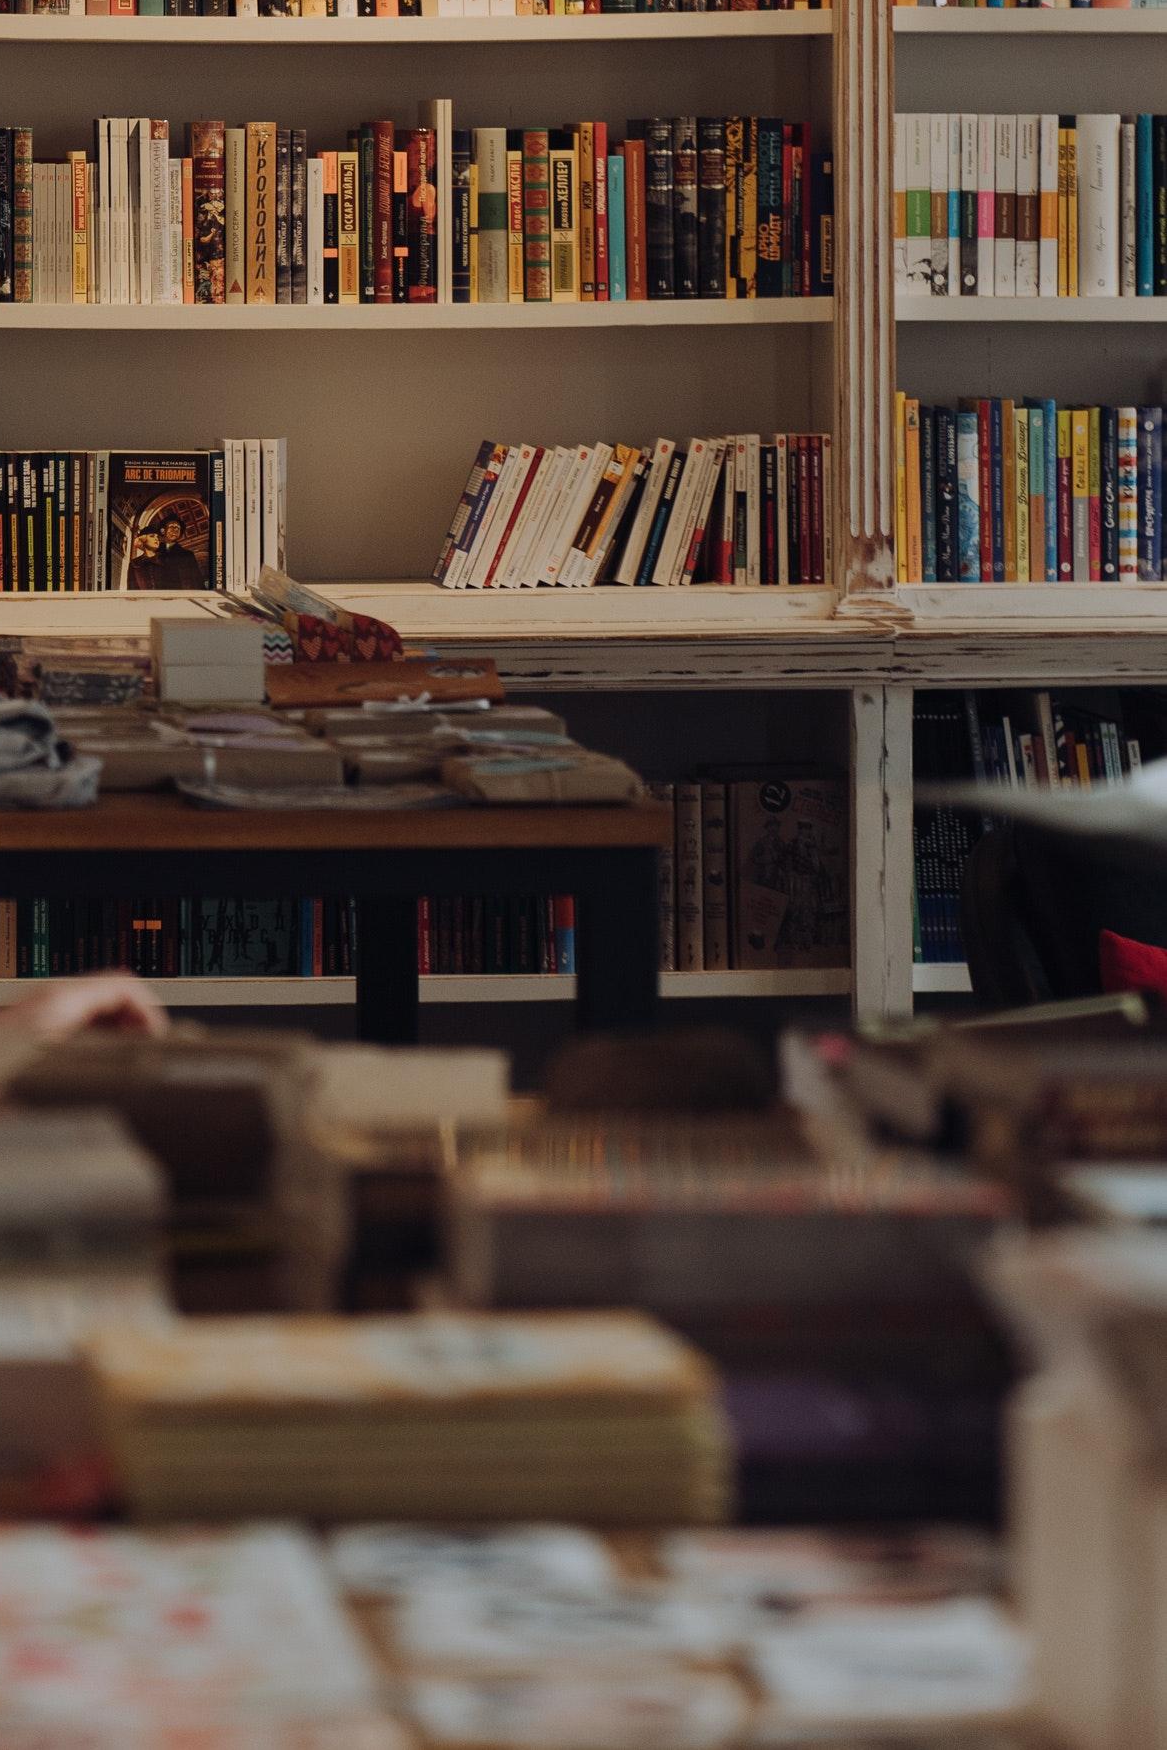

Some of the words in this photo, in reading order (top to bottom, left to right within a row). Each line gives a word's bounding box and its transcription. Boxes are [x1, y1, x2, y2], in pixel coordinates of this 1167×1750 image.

[342, 163, 354, 200] УАЙЛЬД
[511, 164, 521, 203] ХАКСЛИ
[343, 202, 353, 230] ОСКАР
[759, 224, 769, 259] АРНО
[770, 214, 781, 260] ШМИДТ
[125, 469, 141, 479] ARC
[144, 469, 153, 479] DE
[156, 469, 195, 480] TRIOMPHE
